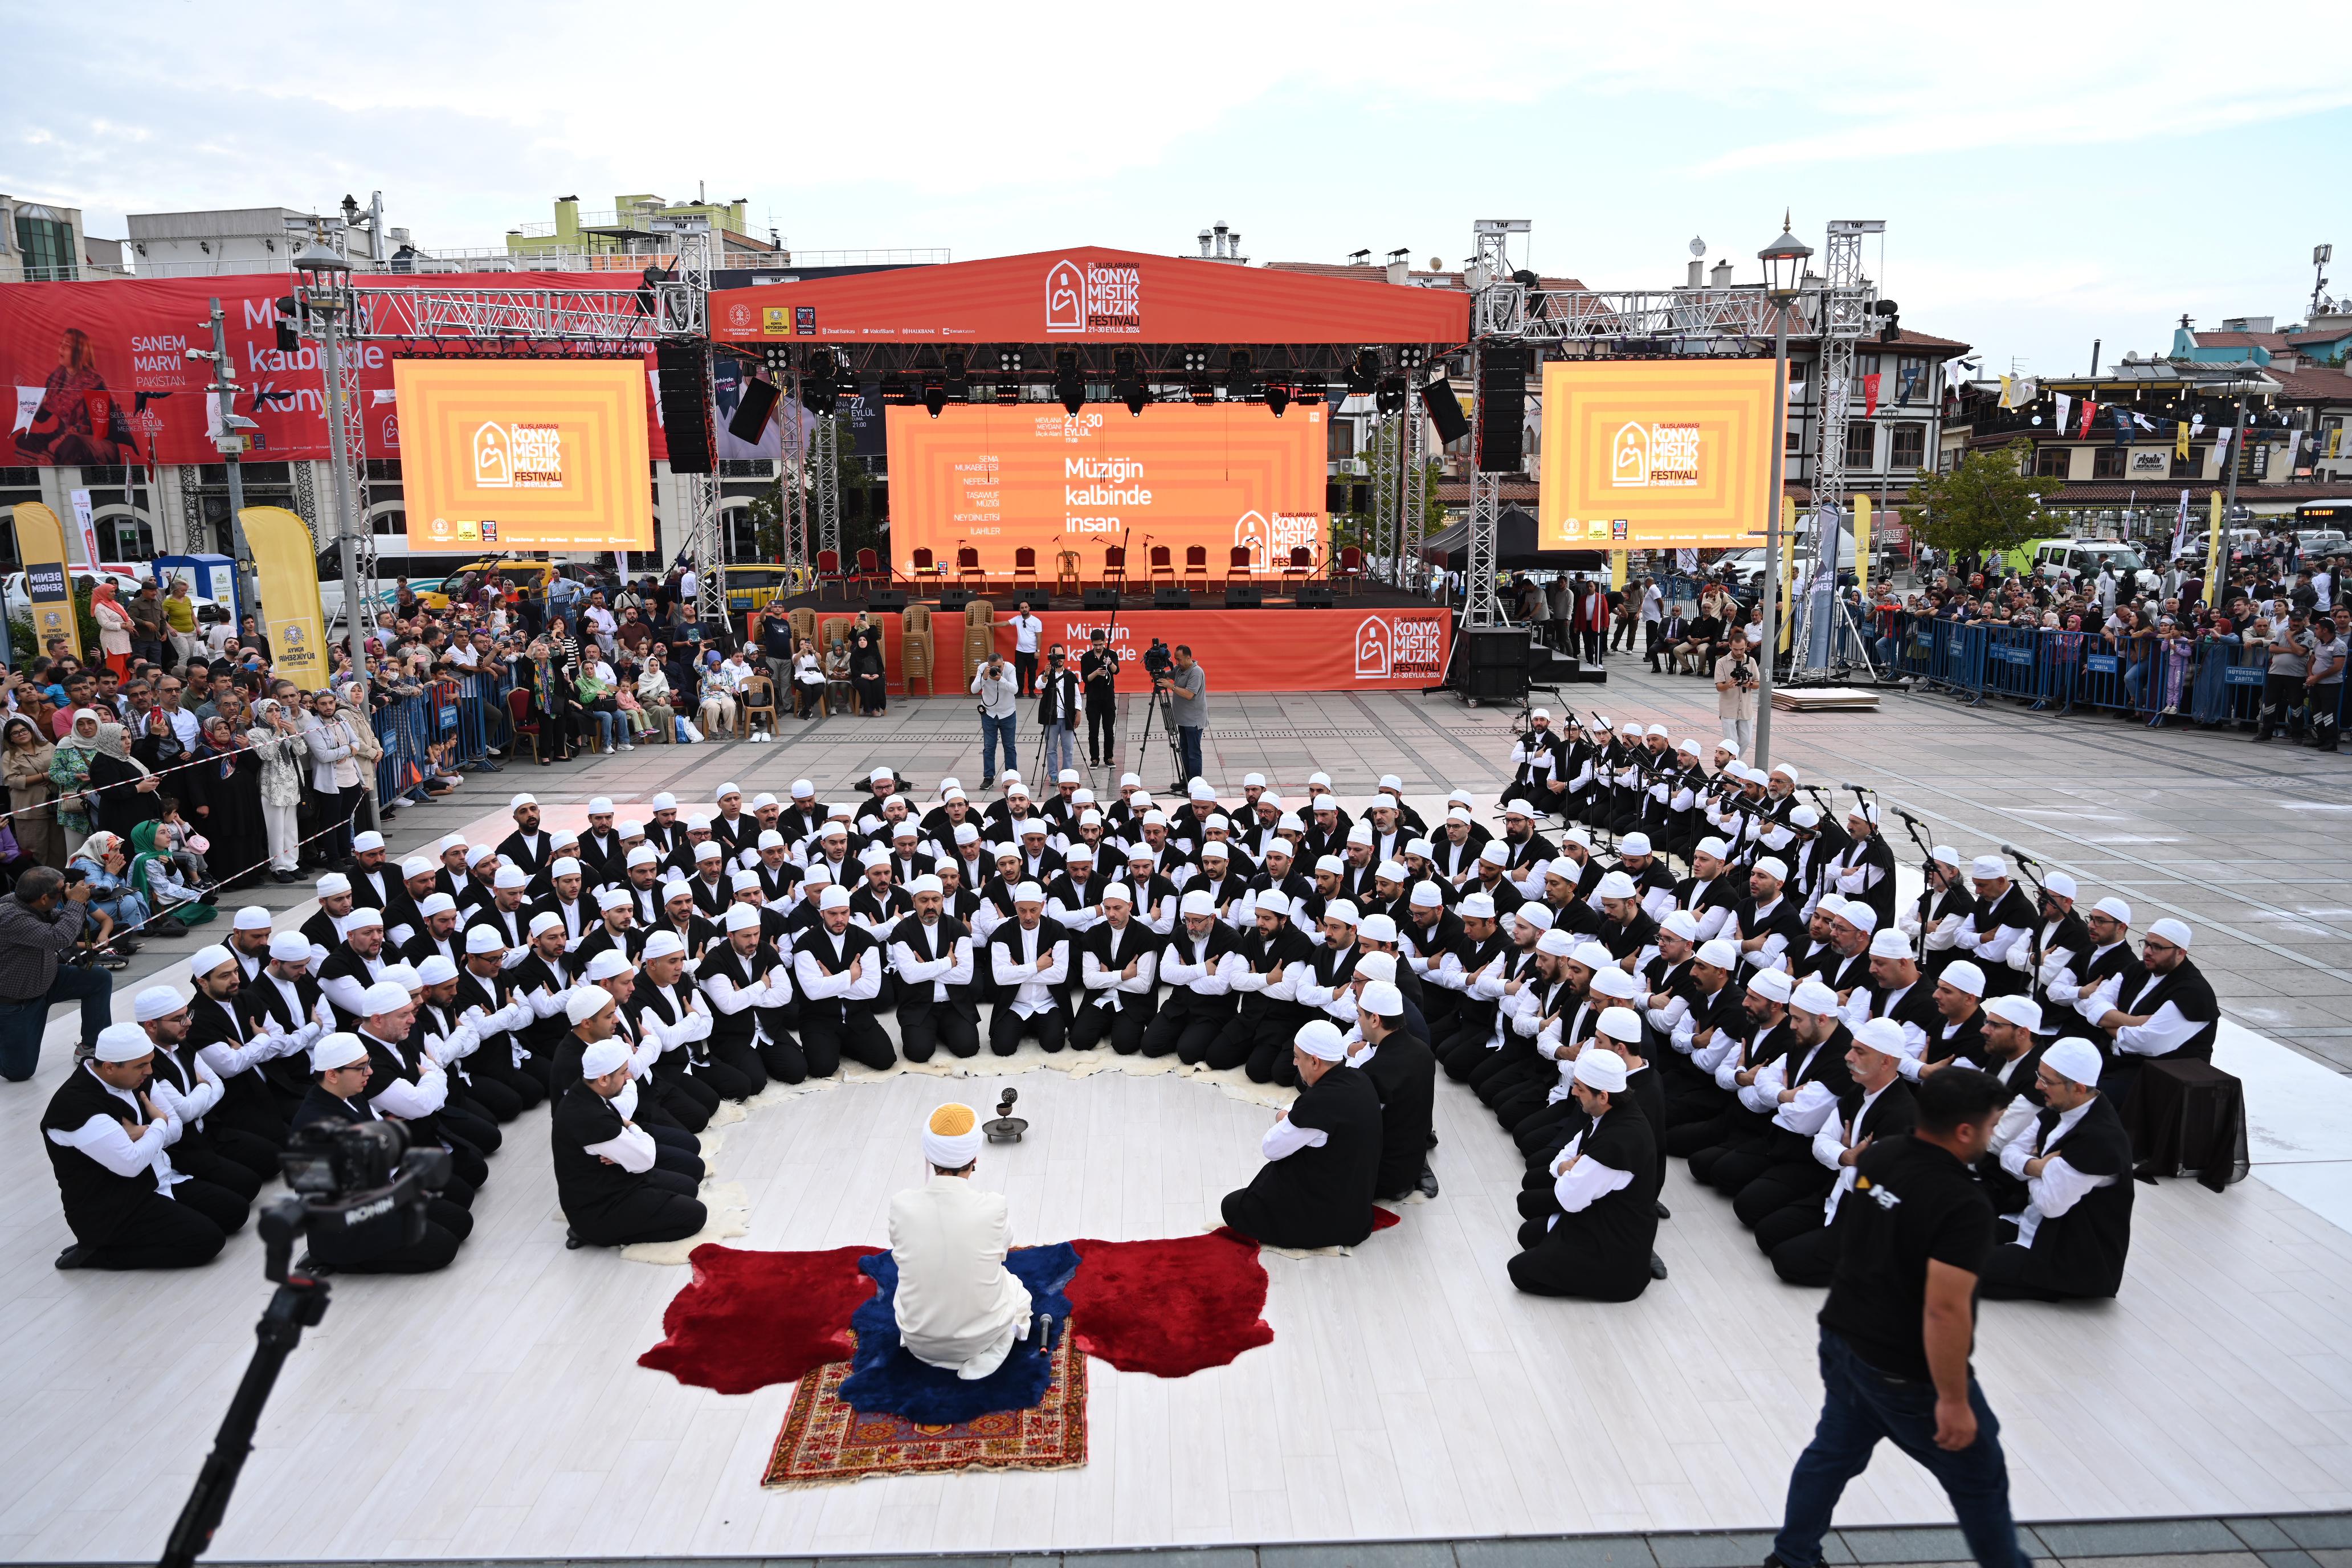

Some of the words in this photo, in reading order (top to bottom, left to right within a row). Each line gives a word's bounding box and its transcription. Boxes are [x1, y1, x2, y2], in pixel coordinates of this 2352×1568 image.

[1088, 269, 1140, 284] KONYA
[132, 335, 186, 352] SANEM
[134, 352, 181, 371] MARVİ
[136, 374, 185, 387] PAKİSTAN
[851, 397, 865, 409] 27
[141, 408, 154, 419] 26
[852, 408, 875, 416] EYLÜL
[142, 418, 165, 427] EYLÜL
[1064, 414, 1102, 427] 21-30
[512, 430, 561, 443] KONYA
[1064, 426, 1092, 436] EYLÜL
[1653, 428, 1700, 442] KONYA
[1066, 458, 1143, 483] Müziğin
[1066, 485, 1152, 505] kalbinde
[1066, 513, 1120, 532] insan
[1272, 517, 1318, 530] KONYA
[1394, 622, 1440, 635] KONYA
